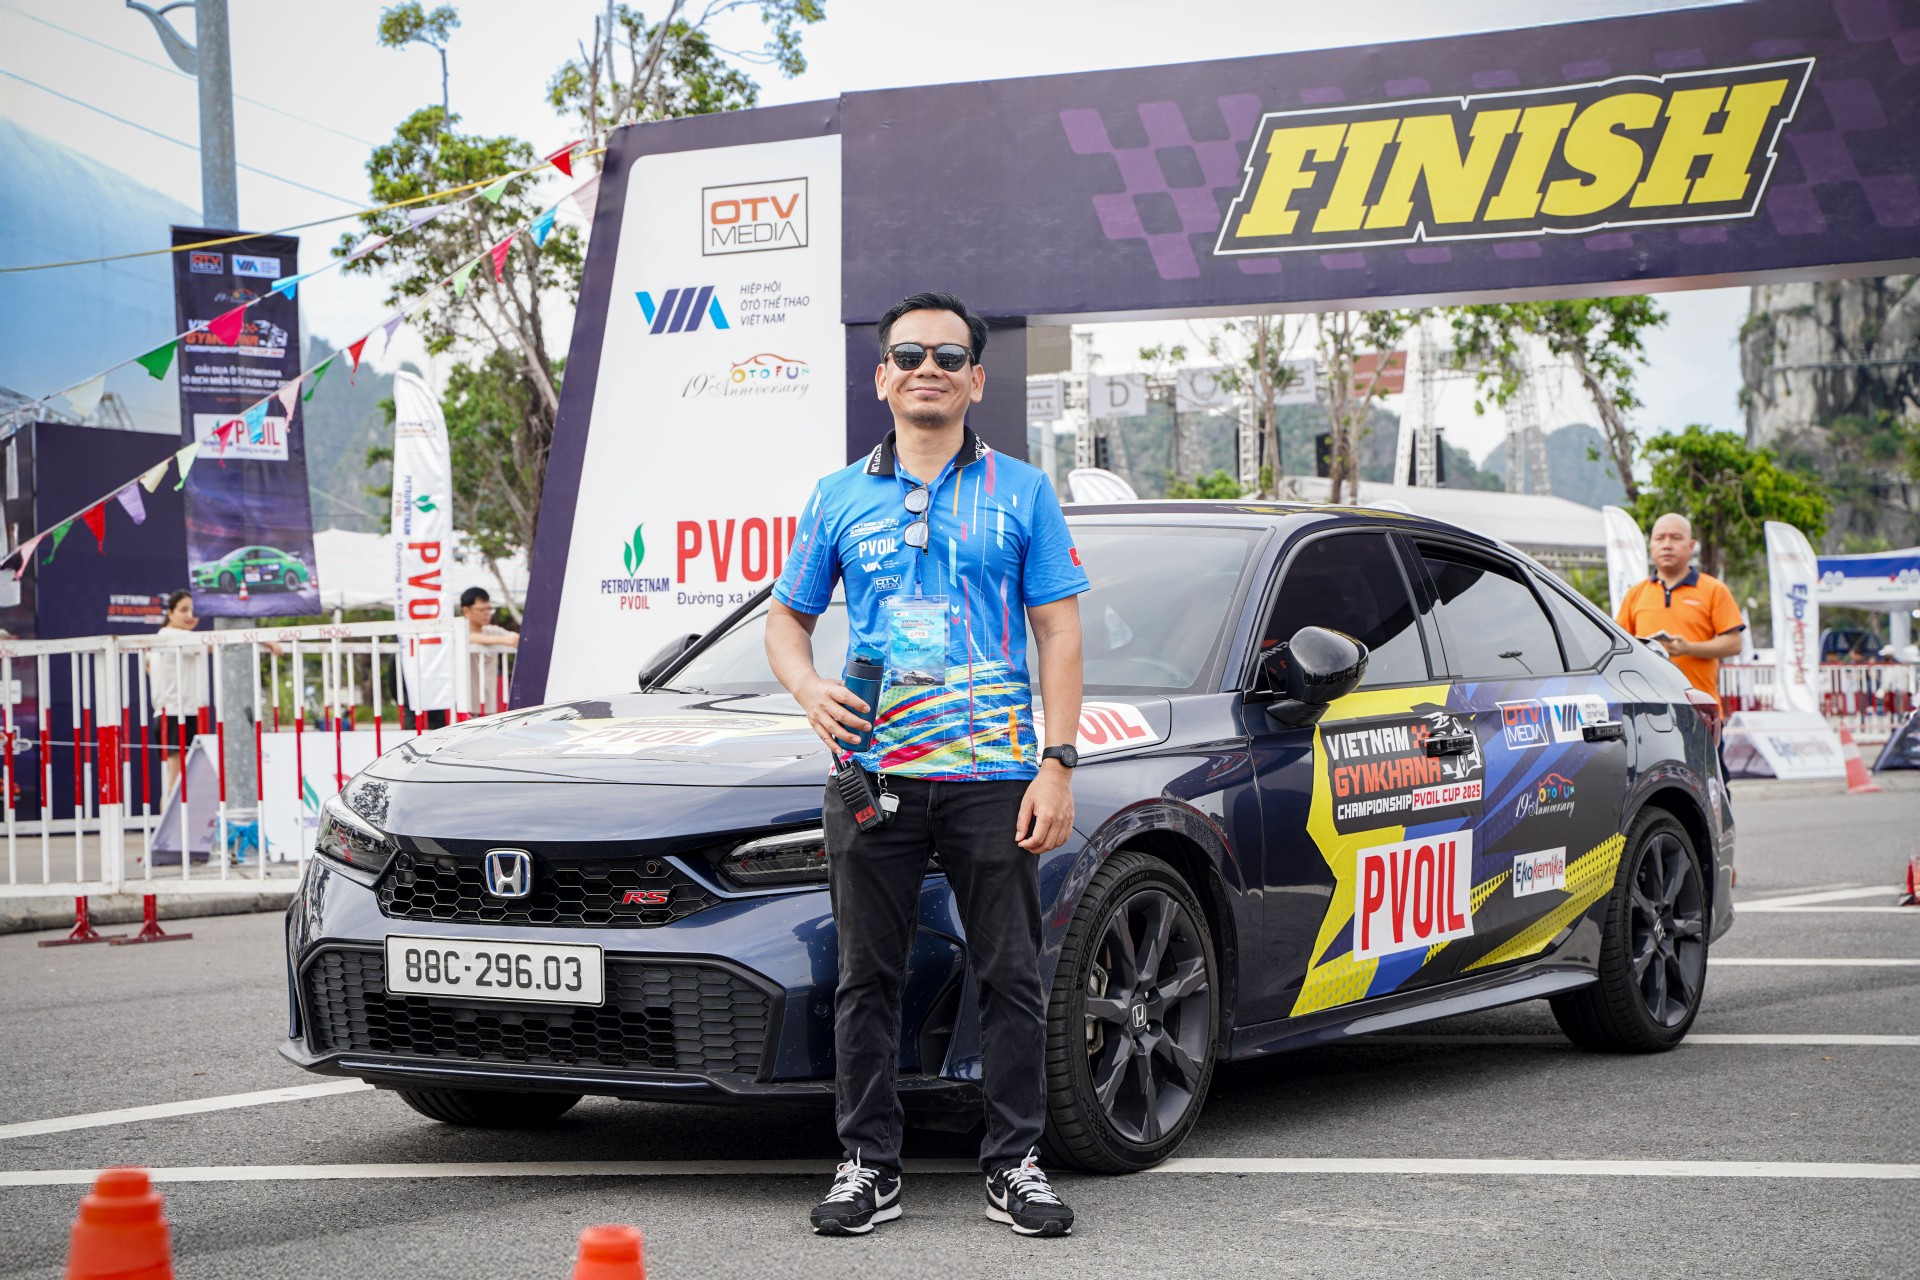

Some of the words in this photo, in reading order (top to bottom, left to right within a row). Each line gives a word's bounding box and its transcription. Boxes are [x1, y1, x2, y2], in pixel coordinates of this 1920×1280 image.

[1235, 78, 1789, 239] FINISH
[711, 193, 800, 225] OTV
[711, 221, 801, 247] MEDIA
[784, 296, 810, 308] THAO
[764, 313, 785, 324] NAM
[732, 365, 809, 384] OTOFUN
[858, 538, 898, 558] PVOIL
[601, 577, 670, 594] PETROVIETNAM
[876, 576, 900, 585] OTV
[620, 595, 650, 610] PVOIL
[677, 591, 724, 607] Đường
[728, 593, 744, 604] xa
[1504, 703, 1539, 726] OTV
[1326, 725, 1411, 760] VIETNAM
[1506, 723, 1544, 744] MEDIA
[1334, 755, 1442, 798] GYMKHANA
[1338, 794, 1412, 820] CHAMPIONSHIP
[1413, 790, 1441, 808] PVOIL
[1442, 786, 1461, 803] CUP
[1462, 783, 1481, 800] 2025
[1538, 785, 1576, 803] OTOFUN
[1515, 854, 1564, 893] Ekokemika
[622, 890, 670, 905] RS
[1361, 840, 1466, 951] PVOIL
[405, 948, 582, 992] 88C-296.03
